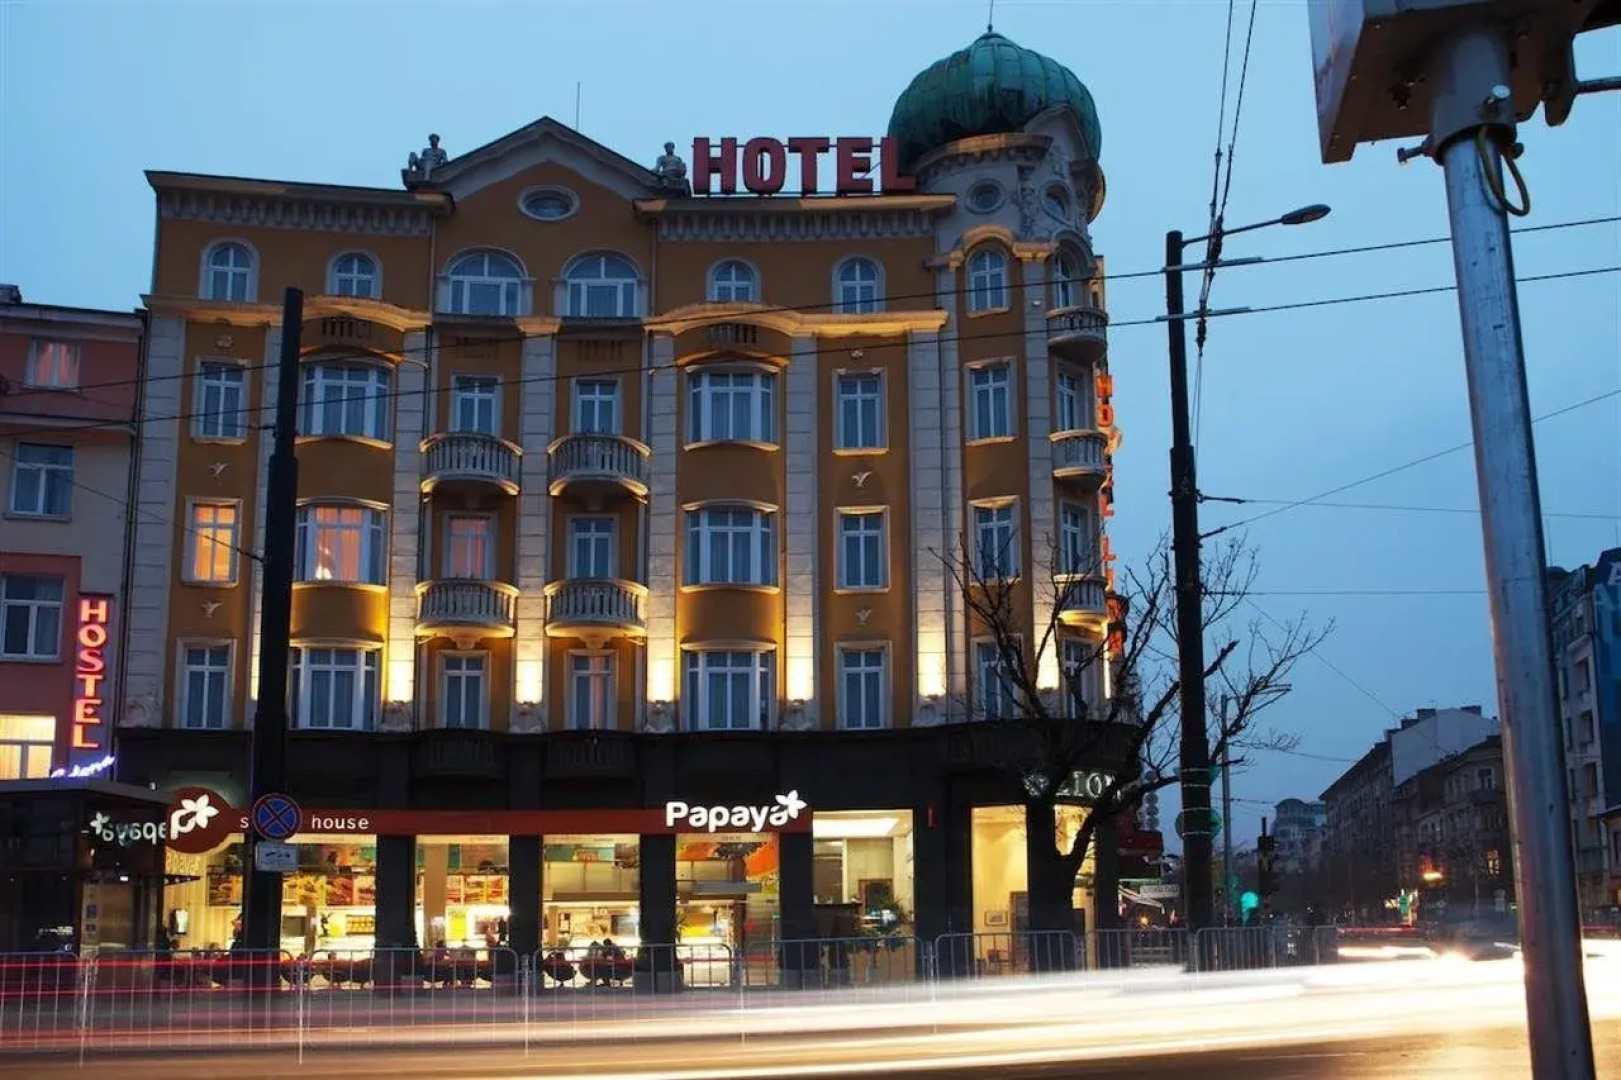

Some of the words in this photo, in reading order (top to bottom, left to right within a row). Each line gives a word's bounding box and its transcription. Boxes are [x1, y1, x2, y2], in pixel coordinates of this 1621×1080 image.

[693, 137, 916, 195] HOTEL
[1097, 375, 1114, 517] HOL
[73, 600, 107, 748] HOSTEL
[311, 814, 369, 829] house
[665, 801, 788, 832] Papaya
